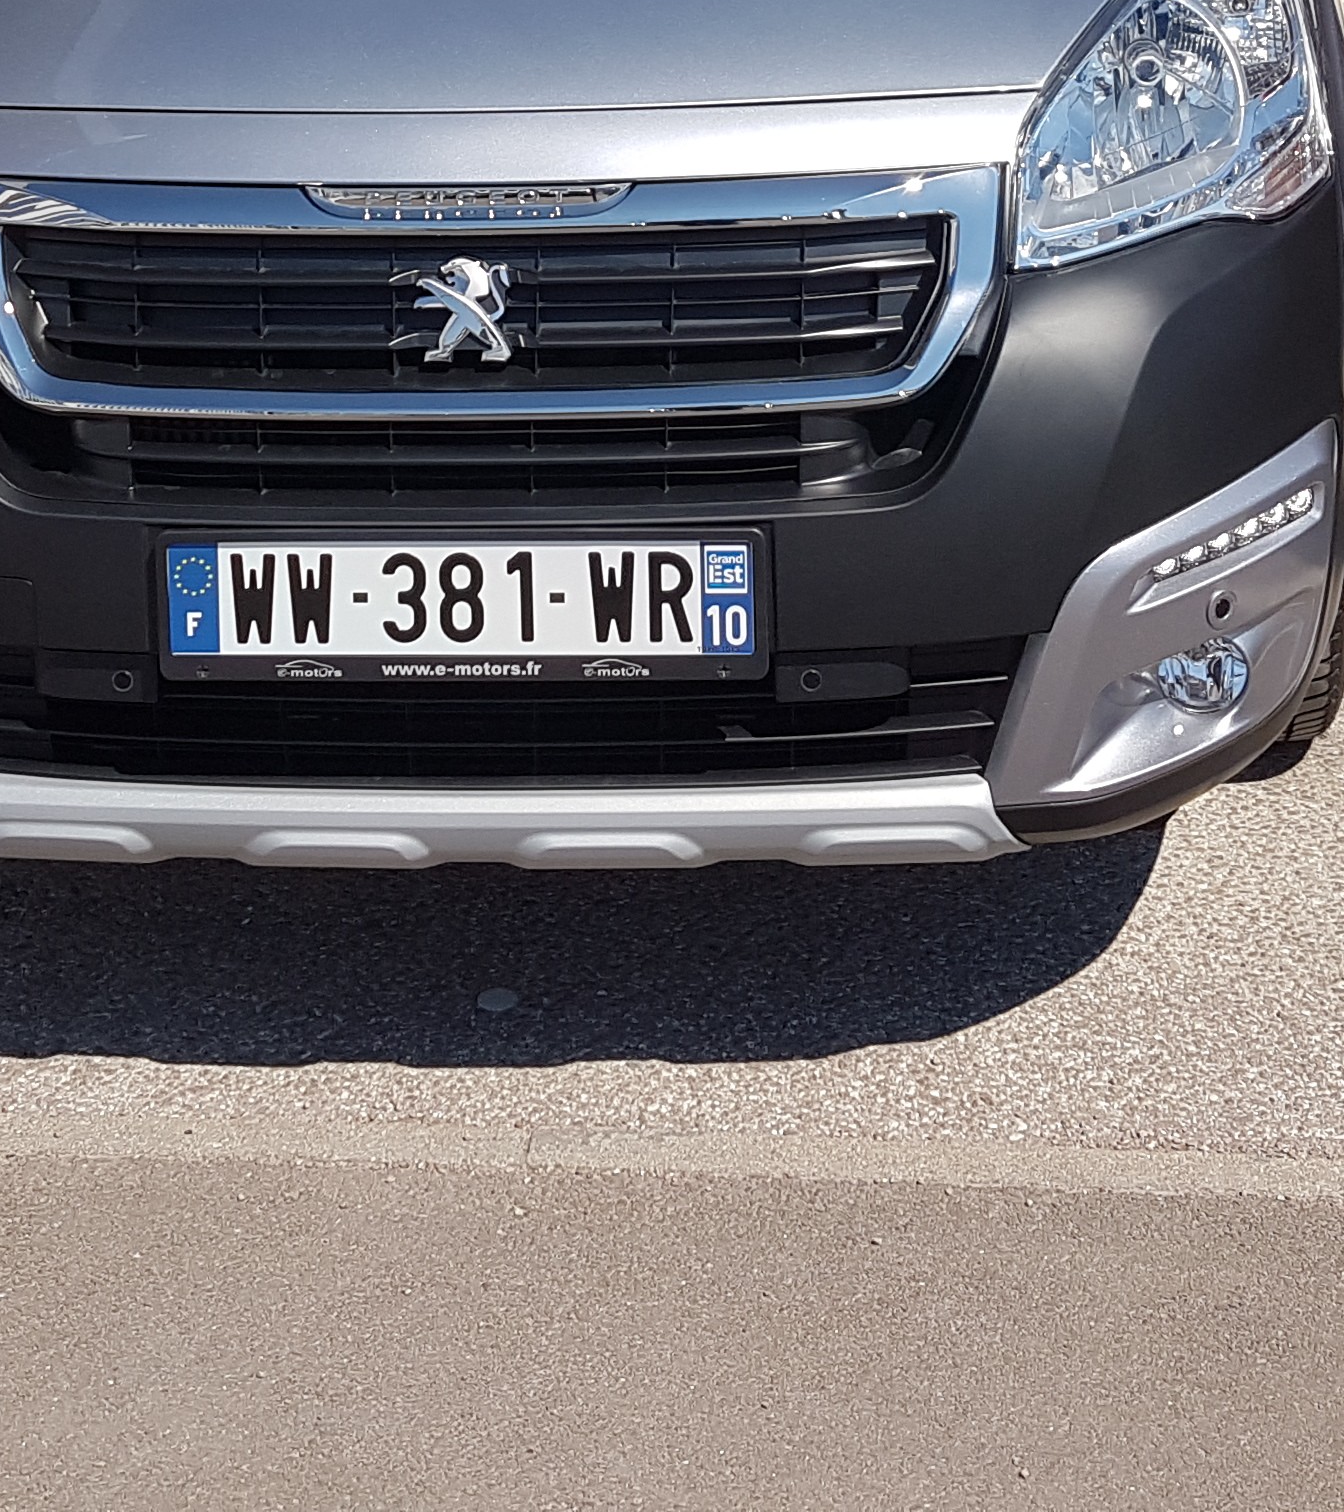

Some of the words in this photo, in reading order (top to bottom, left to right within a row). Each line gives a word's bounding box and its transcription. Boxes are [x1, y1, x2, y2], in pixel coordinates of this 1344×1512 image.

[364, 189, 569, 206] PEUGEOT
[708, 553, 744, 564] Grand
[708, 565, 744, 583] Est
[186, 612, 203, 637] F
[706, 604, 747, 646] 10
[277, 667, 343, 678] e-motors
[381, 661, 543, 676] www.e-motors.fr
[583, 666, 650, 677] e-motors
